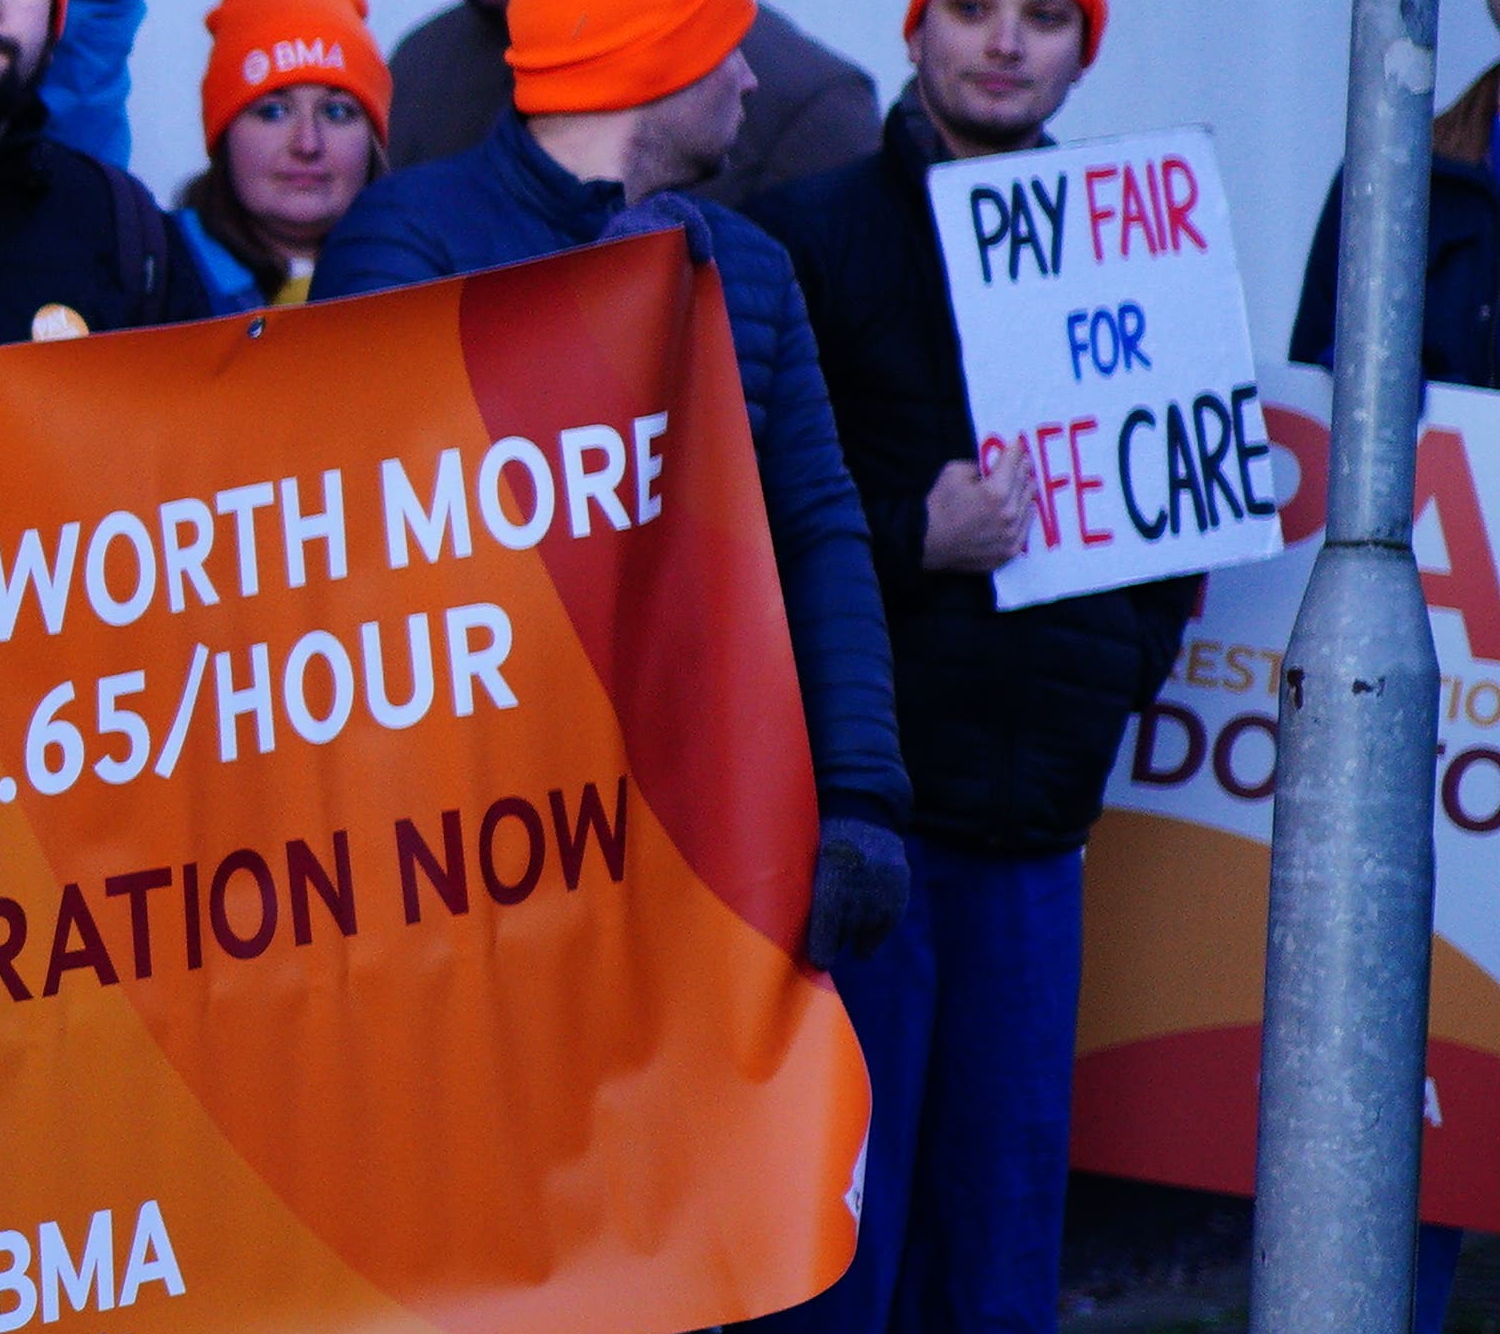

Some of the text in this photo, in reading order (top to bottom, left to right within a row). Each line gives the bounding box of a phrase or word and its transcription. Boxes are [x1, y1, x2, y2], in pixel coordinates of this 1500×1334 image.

[272, 37, 347, 73] BMA
[969, 154, 1209, 285] PAY FAIR
[1066, 303, 1153, 381] FOR
[379, 409, 669, 571] MORE
[1117, 381, 1276, 543] CARE
[394, 775, 630, 925] NOW
